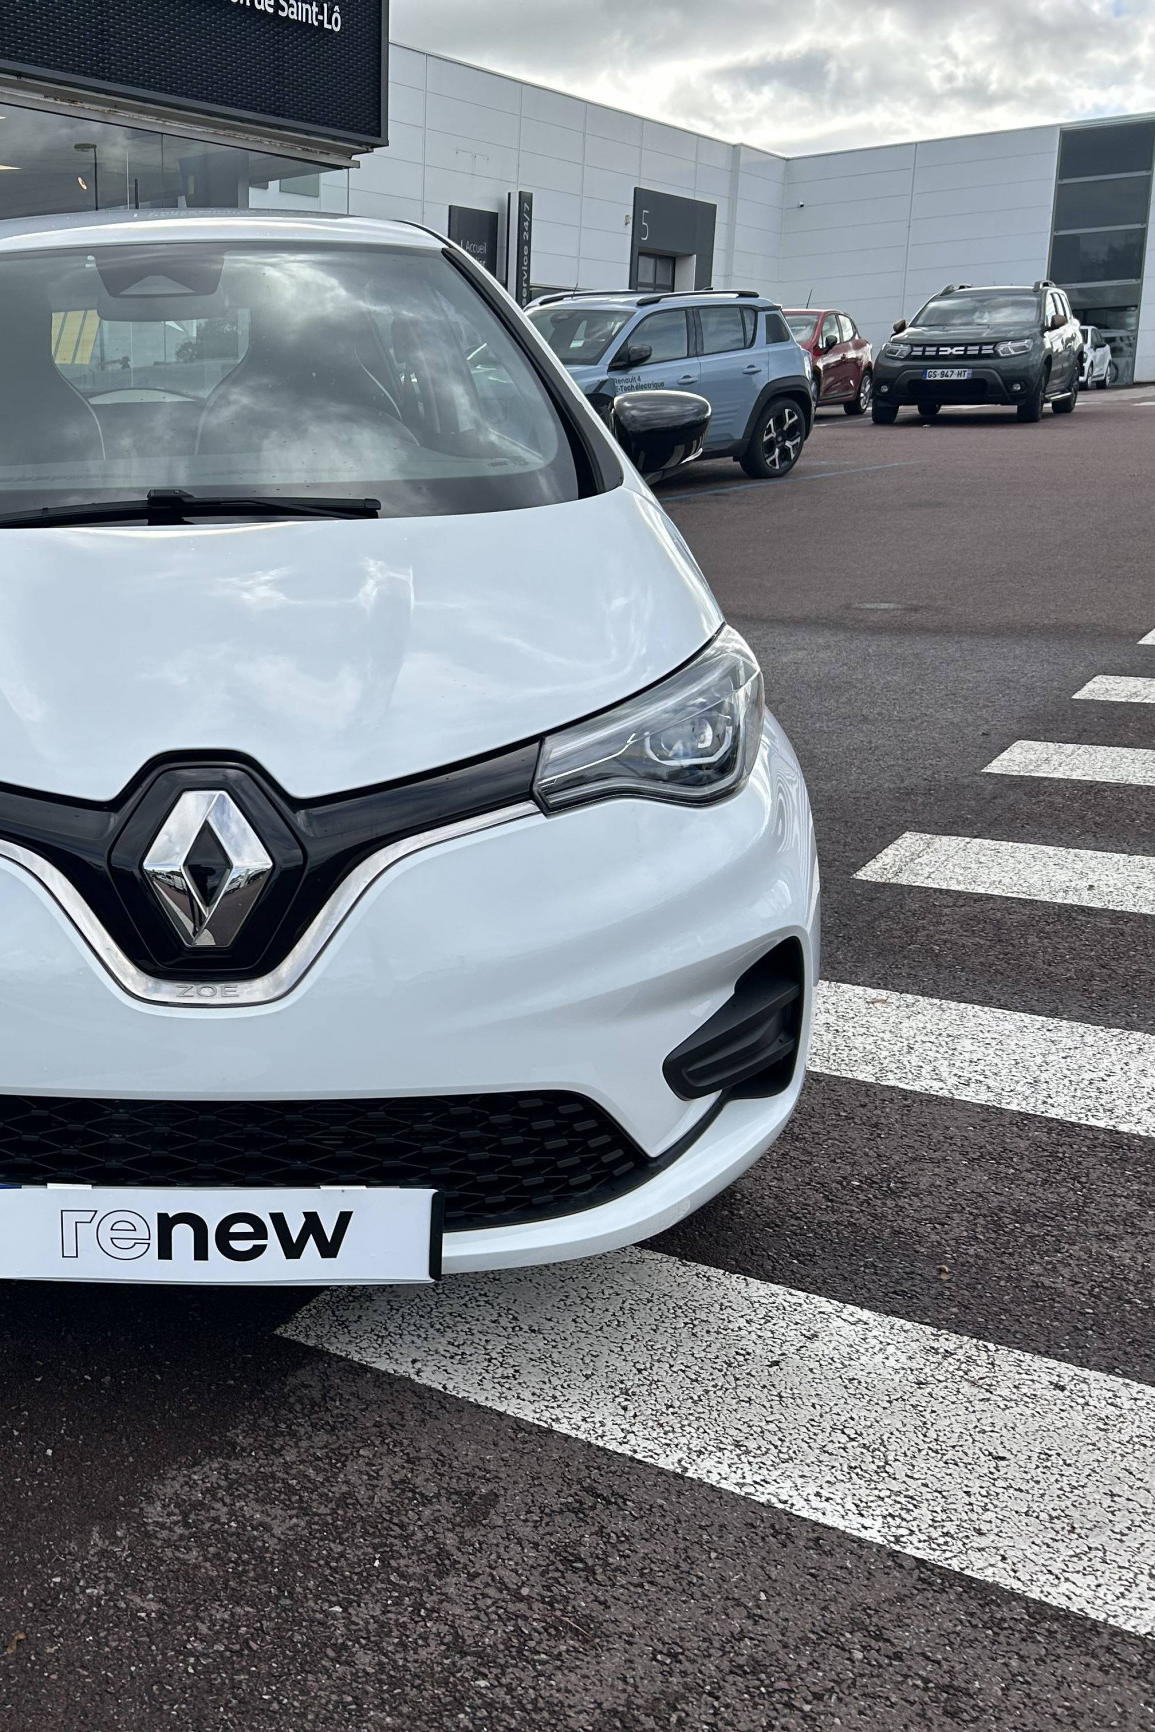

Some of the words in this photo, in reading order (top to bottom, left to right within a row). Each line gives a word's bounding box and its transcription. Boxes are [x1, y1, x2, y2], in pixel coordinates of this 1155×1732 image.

[278, 0, 342, 32] Saint-Lô
[522, 202, 531, 240] 24/7
[640, 209, 650, 241] 5
[175, 984, 240, 998] ZOE
[59, 1208, 355, 1263] renew
